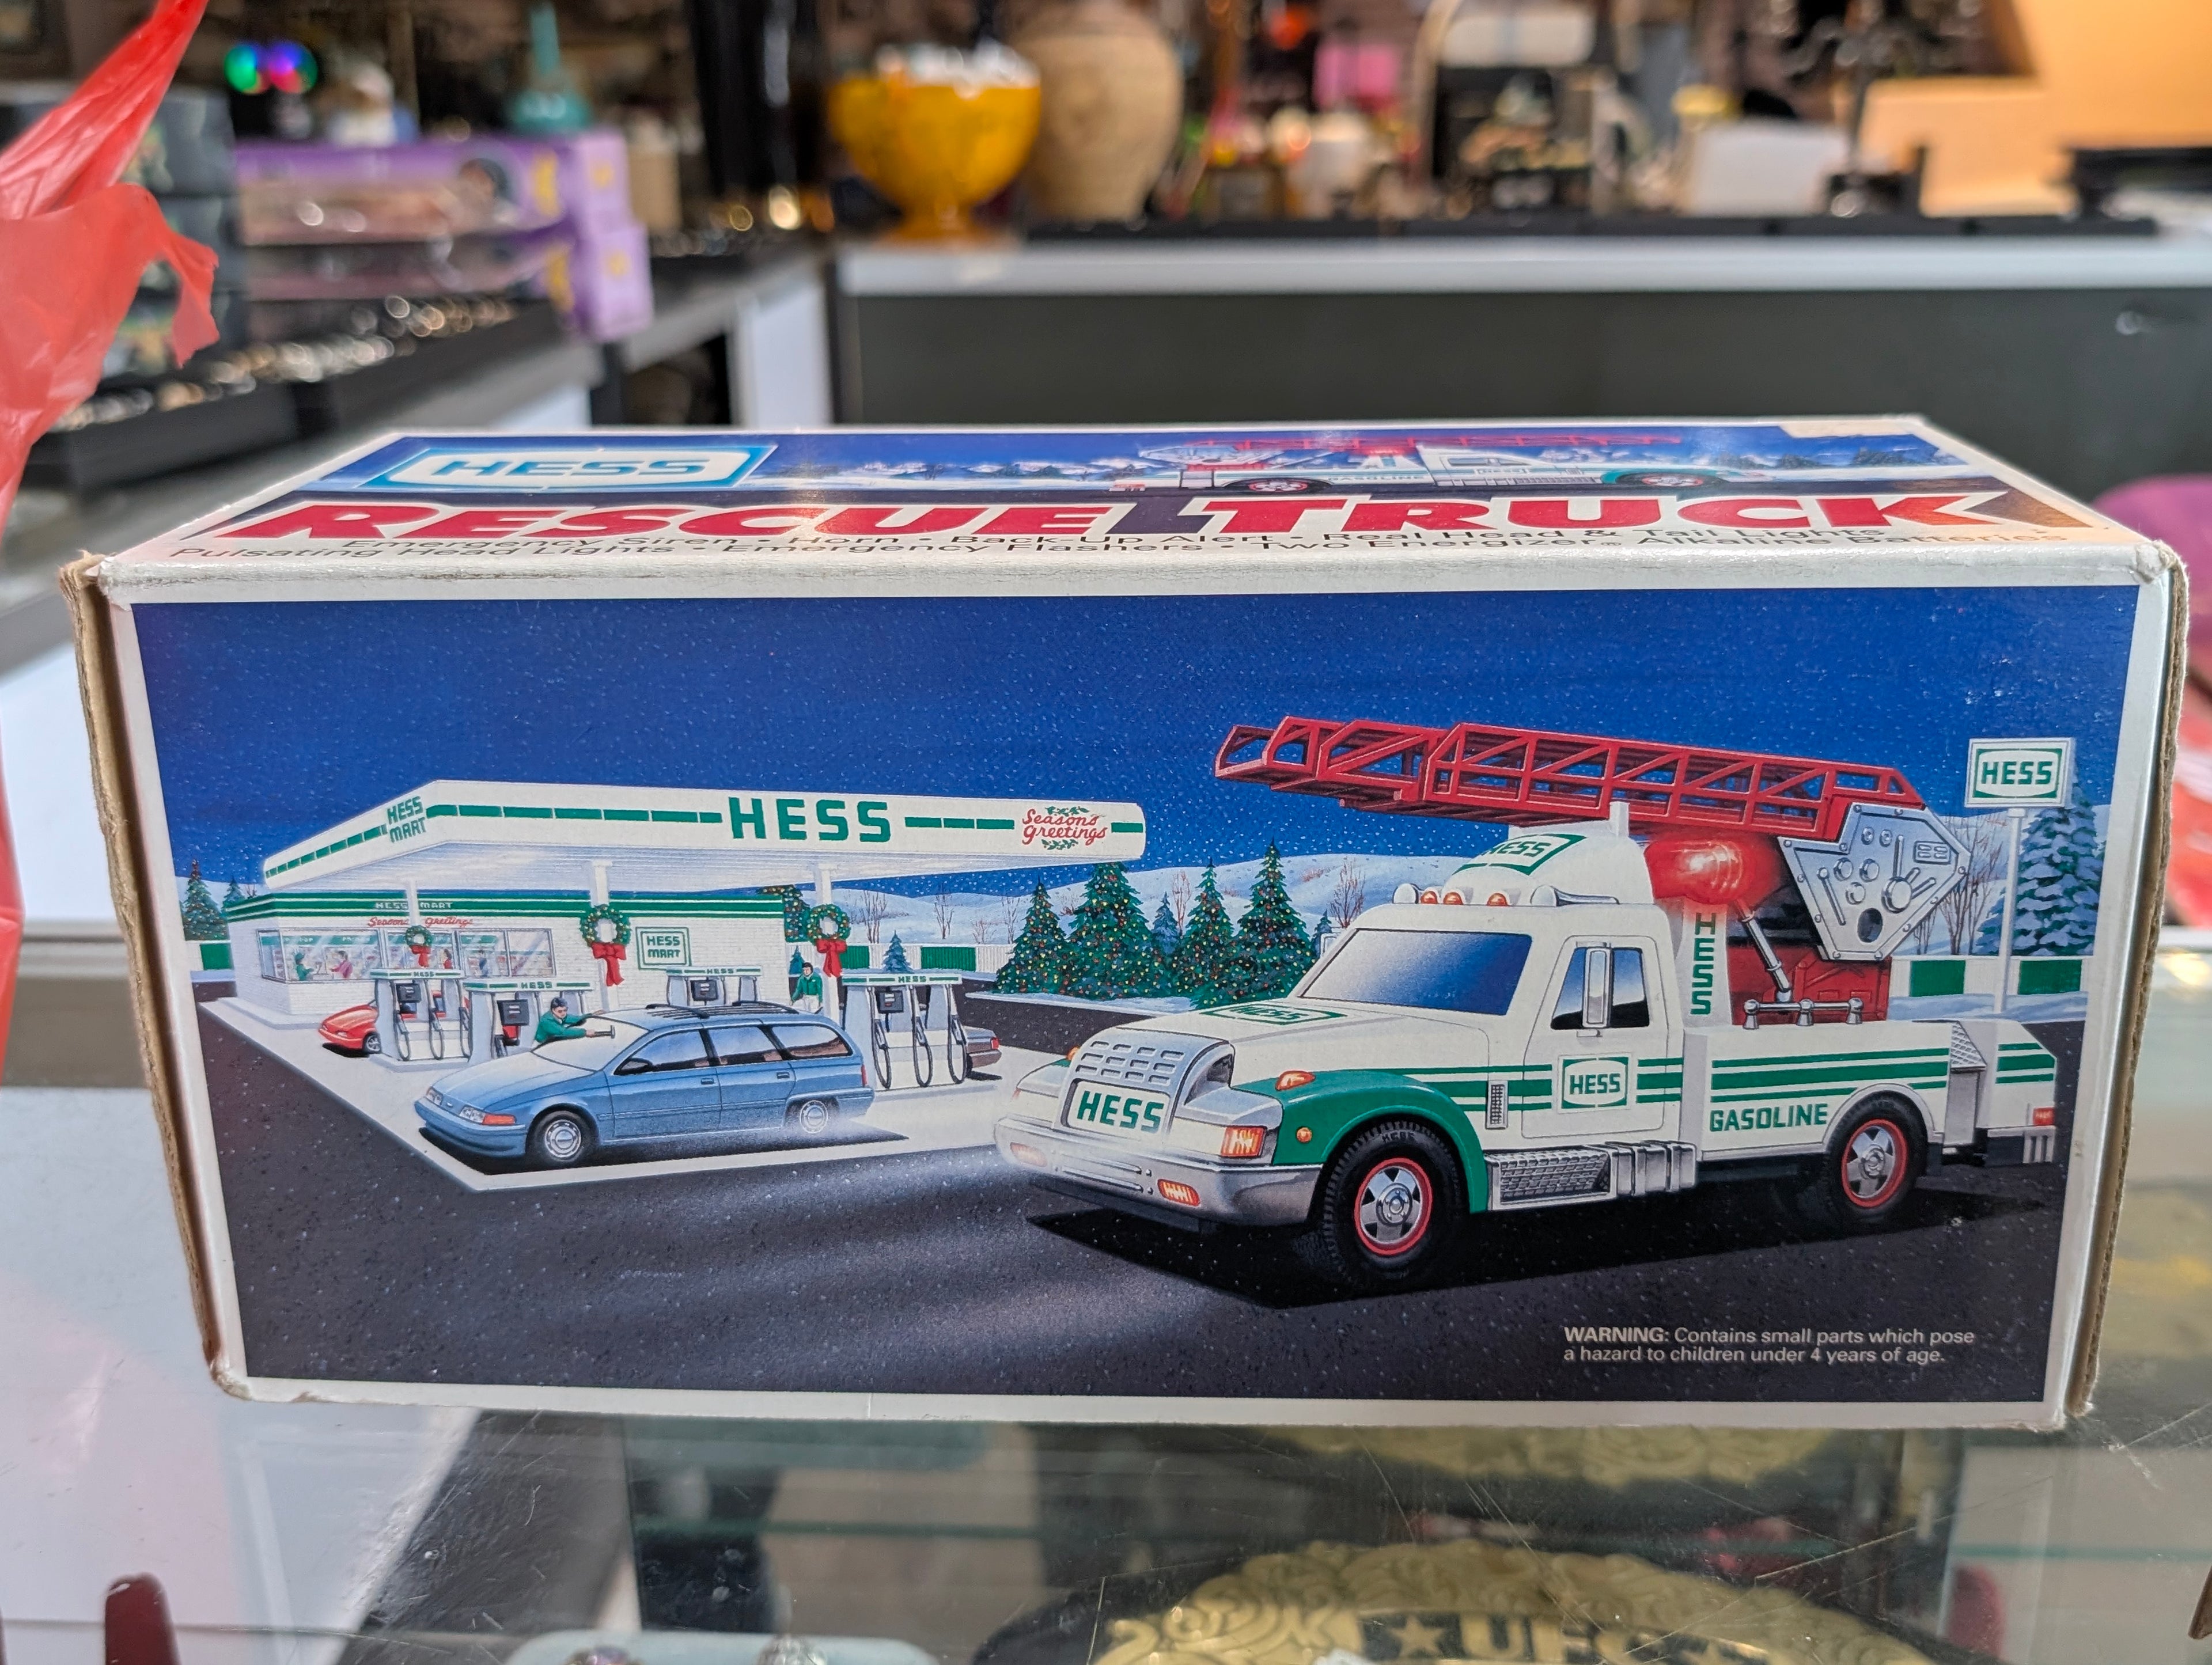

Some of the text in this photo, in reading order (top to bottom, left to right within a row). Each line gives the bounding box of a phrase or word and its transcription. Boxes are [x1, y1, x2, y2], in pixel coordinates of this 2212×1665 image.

[431, 460, 709, 476] HESS
[214, 496, 2003, 538] RESCUE TRUCK
[169, 548, 383, 557] Pulsating
[397, 548, 521, 556] Head
[532, 546, 675, 555] Lights
[723, 545, 989, 553] Emergency
[1847, 535, 2067, 544] Batteries
[342, 540, 603, 548] Emergency
[951, 536, 1143, 544] Back-Up
[1734, 529, 1884, 538] Lights
[1982, 761, 2052, 785] HESS
[387, 796, 423, 825] HESS
[729, 797, 891, 842] HESS
[1022, 809, 1099, 825] Seasons
[389, 817, 426, 843] MART
[646, 936, 680, 946] HESS
[647, 949, 681, 958] MART
[1690, 912, 1715, 1015] HESS
[1229, 1006, 1309, 1020] HESS
[1570, 1073, 1621, 1095] HESS
[1076, 1090, 1164, 1133] HESS
[1710, 1103, 1828, 1132] GASOLINE
[1563, 1326, 1975, 1347] WARNING: Contains small parts which pose
[1563, 1346, 1945, 1366] a hazard to children under 4 years of age.
